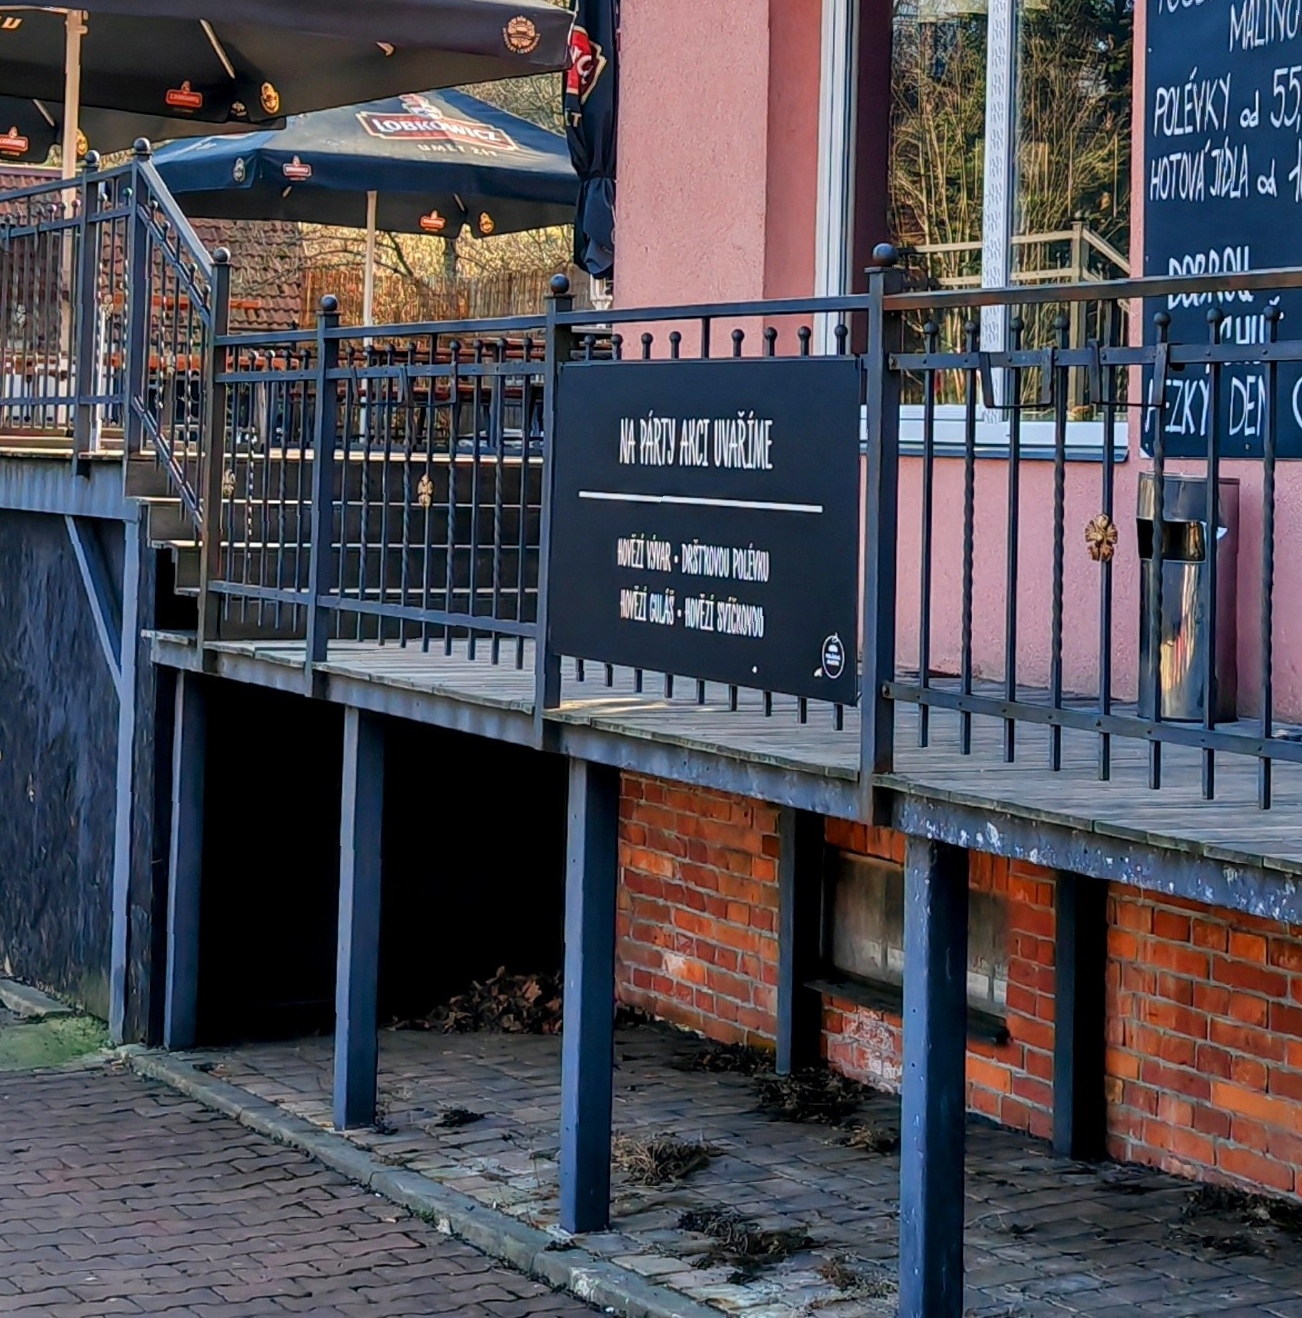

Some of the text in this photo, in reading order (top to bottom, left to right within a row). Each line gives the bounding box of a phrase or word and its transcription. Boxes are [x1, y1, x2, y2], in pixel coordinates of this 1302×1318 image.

[371, 118, 501, 141] LOBKOWICZ
[1153, 65, 1232, 138] POLÉVKY
[1239, 88, 1260, 129] od
[1149, 138, 1212, 202] HOTOVÁ
[1209, 134, 1249, 199] JÍDLA
[1257, 158, 1278, 199] od
[619, 409, 774, 470] NA PÁRTY AKCI UVAŘÍME
[617, 532, 645, 569] HOVĚZÍ
